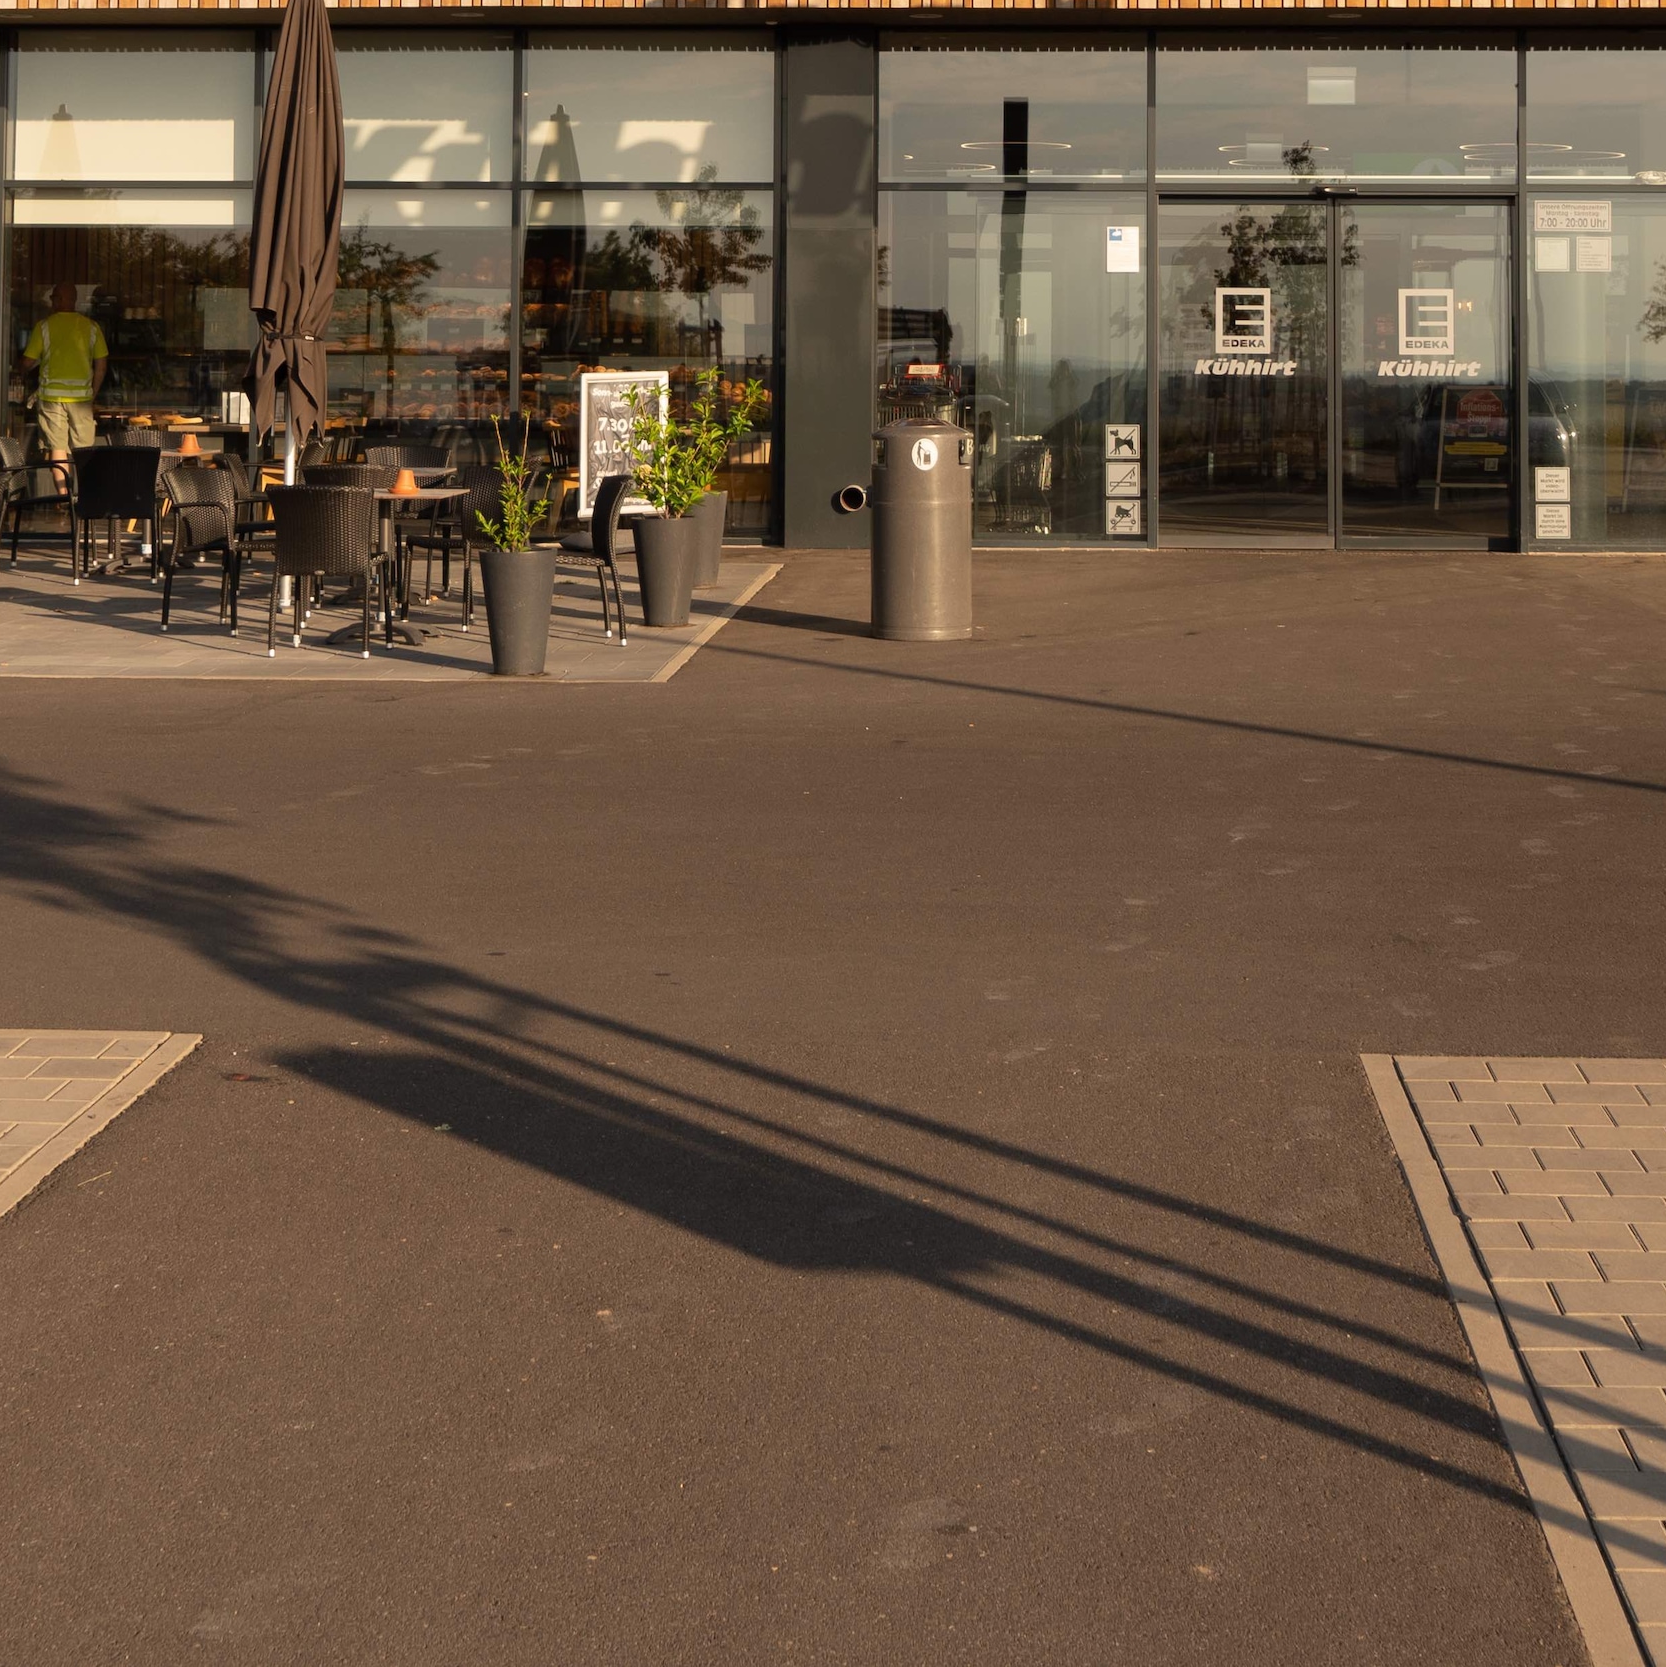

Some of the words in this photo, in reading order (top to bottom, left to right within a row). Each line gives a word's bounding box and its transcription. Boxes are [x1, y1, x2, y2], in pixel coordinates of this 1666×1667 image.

[1561, 203, 1607, 211] Öffnungszeiten
[1539, 218, 1558, 228] 7:00
[1565, 218, 1588, 228] 20:00
[1590, 218, 1607, 228] Uhr
[1222, 339, 1266, 348] EDEKA
[1405, 340, 1449, 349] EDEKA
[1194, 358, 1297, 376] Kühhirt
[1378, 359, 1481, 377] Kühhirt
[1460, 402, 1500, 412] Inflations-
[598, 416, 628, 434] 7.30
